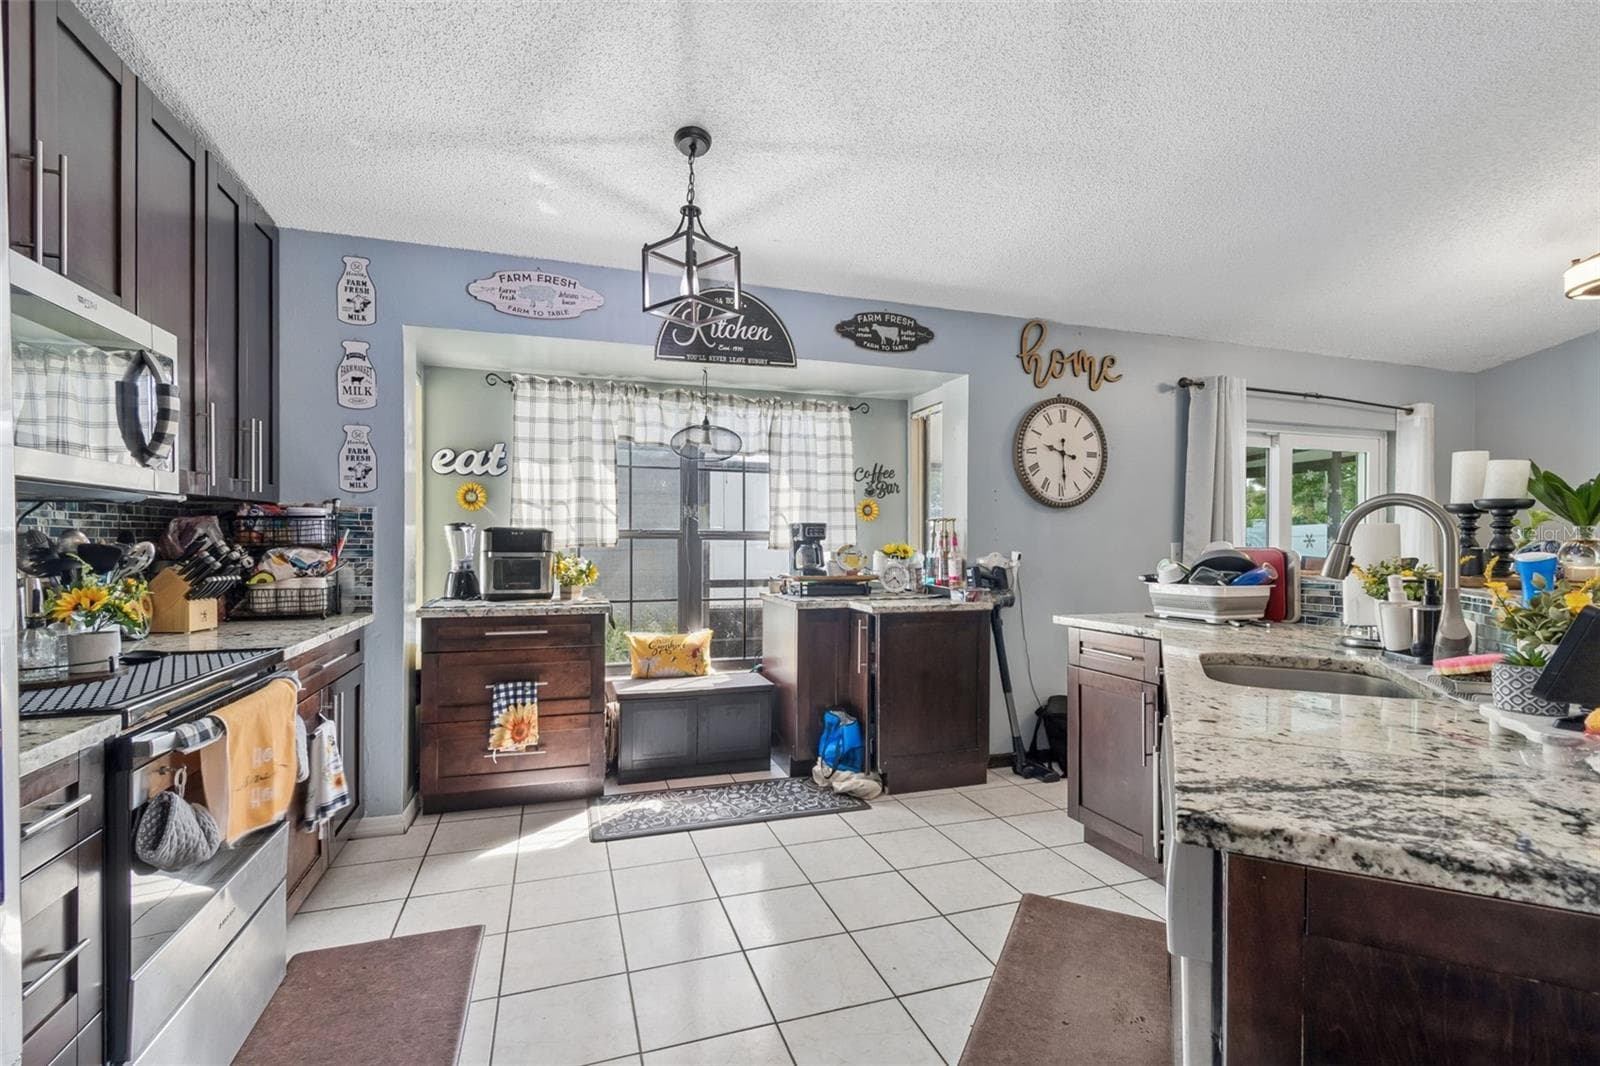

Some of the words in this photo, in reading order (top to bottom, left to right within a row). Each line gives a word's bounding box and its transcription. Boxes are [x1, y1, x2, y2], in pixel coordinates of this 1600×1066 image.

[346, 279, 367, 287] FARM
[499, 273, 532, 284] FARM
[537, 273, 577, 289] FRESH
[344, 286, 370, 294] FRESH
[347, 313, 367, 321] MILK
[507, 305, 530, 315] FARM
[548, 308, 570, 317] TABLE
[672, 304, 773, 347] Kitchen
[857, 314, 882, 323] FARM
[885, 314, 914, 327] FRESH
[863, 340, 880, 349] FARM
[1016, 319, 1123, 391] home
[342, 385, 372, 396] MILK
[347, 447, 369, 455] FARM
[431, 442, 509, 477] eat
[854, 462, 896, 484] Coffee
[349, 481, 369, 489] MILK
[875, 480, 901, 499] Bar
